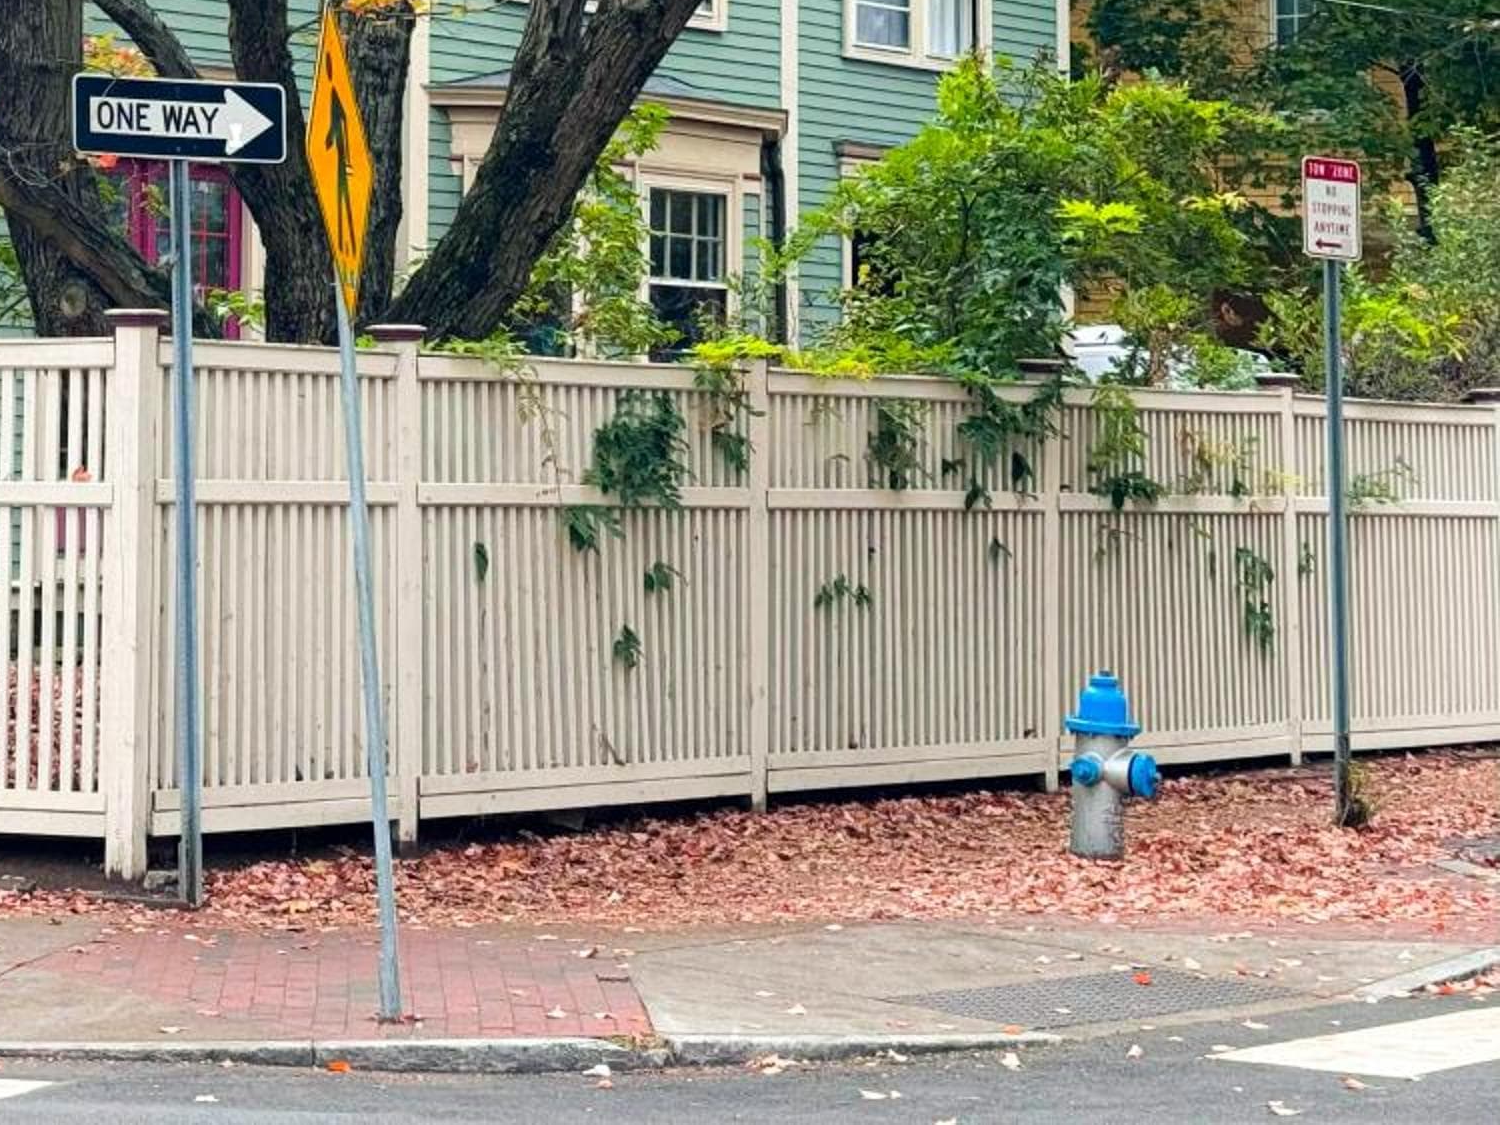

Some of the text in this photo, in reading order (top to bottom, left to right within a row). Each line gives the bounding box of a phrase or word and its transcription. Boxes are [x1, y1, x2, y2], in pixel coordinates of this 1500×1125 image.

[97, 101, 220, 135] ONE WAY
[1313, 220, 1350, 236] ANYTIME
